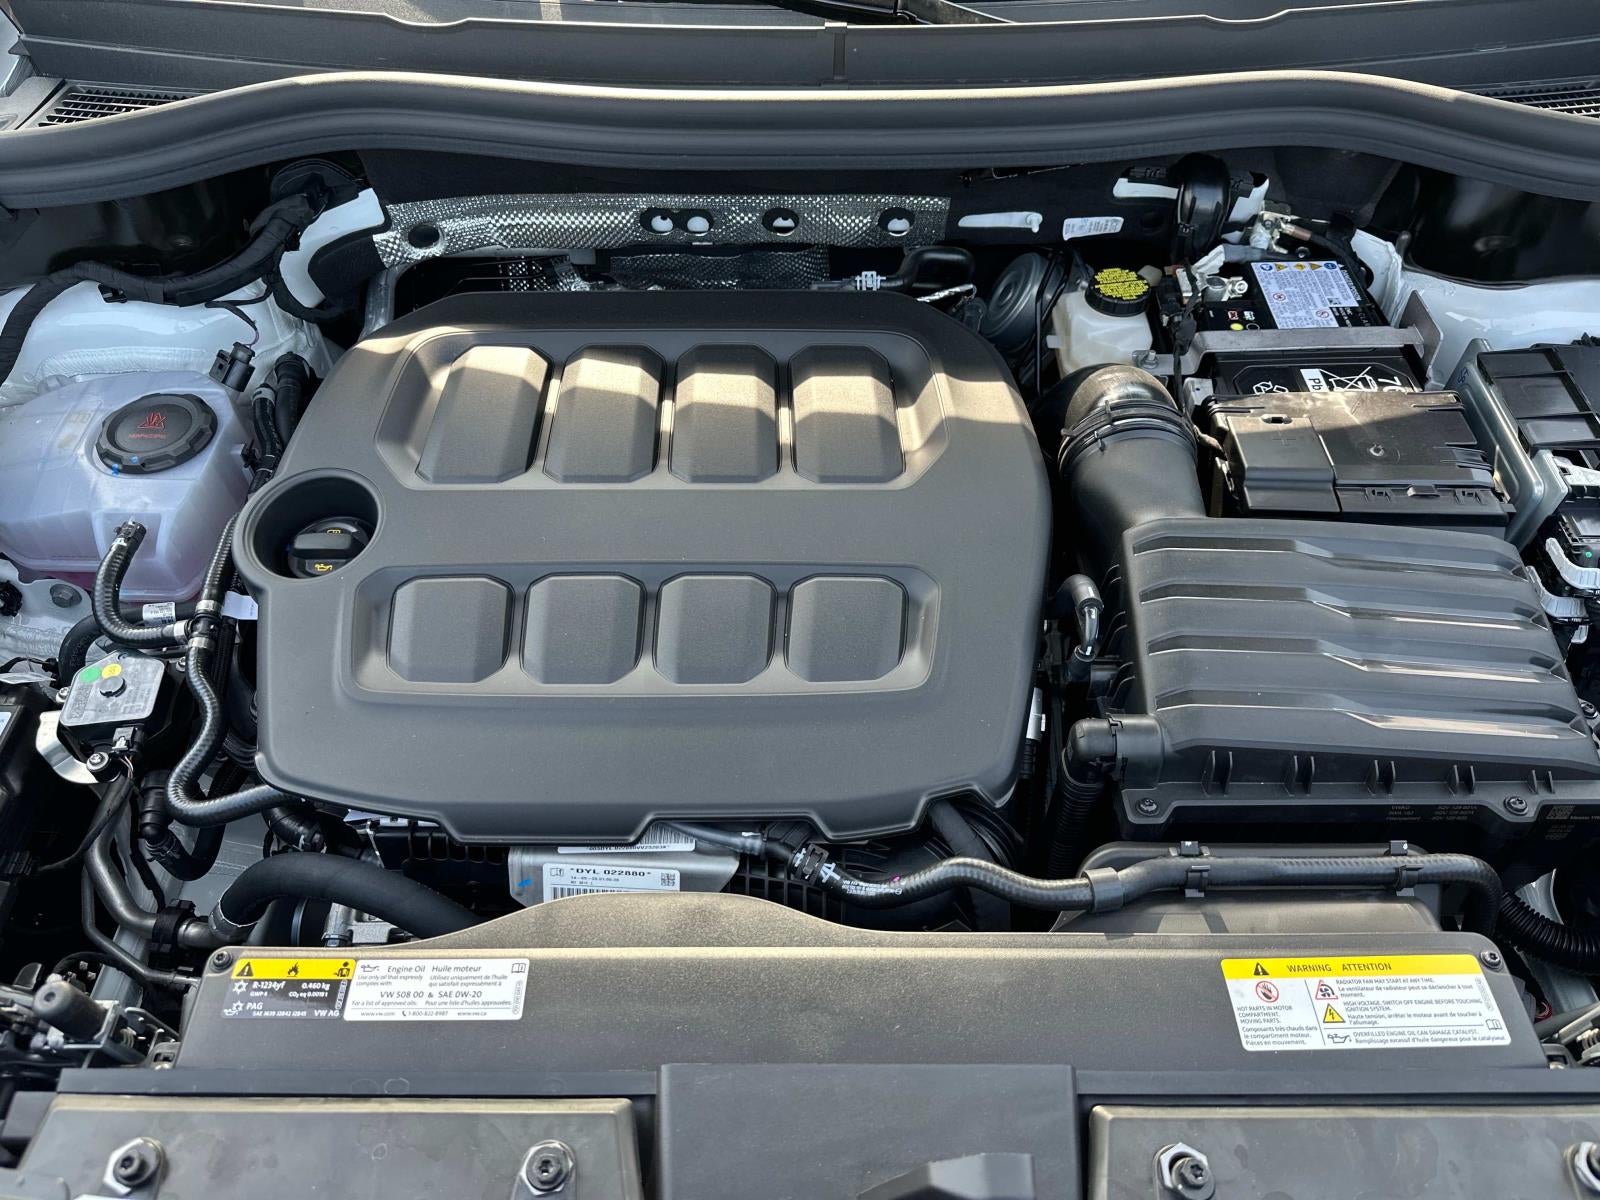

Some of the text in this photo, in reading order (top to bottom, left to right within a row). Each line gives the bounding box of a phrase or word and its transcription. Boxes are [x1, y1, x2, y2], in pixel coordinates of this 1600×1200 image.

[1309, 378, 1322, 391] Pb
[388, 966, 413, 974] Engine
[1287, 963, 1392, 972] WARNING ATTENTION
[252, 981, 286, 991] R-1234yf
[322, 982, 330, 990] kg
[246, 1002, 263, 1010] PAG
